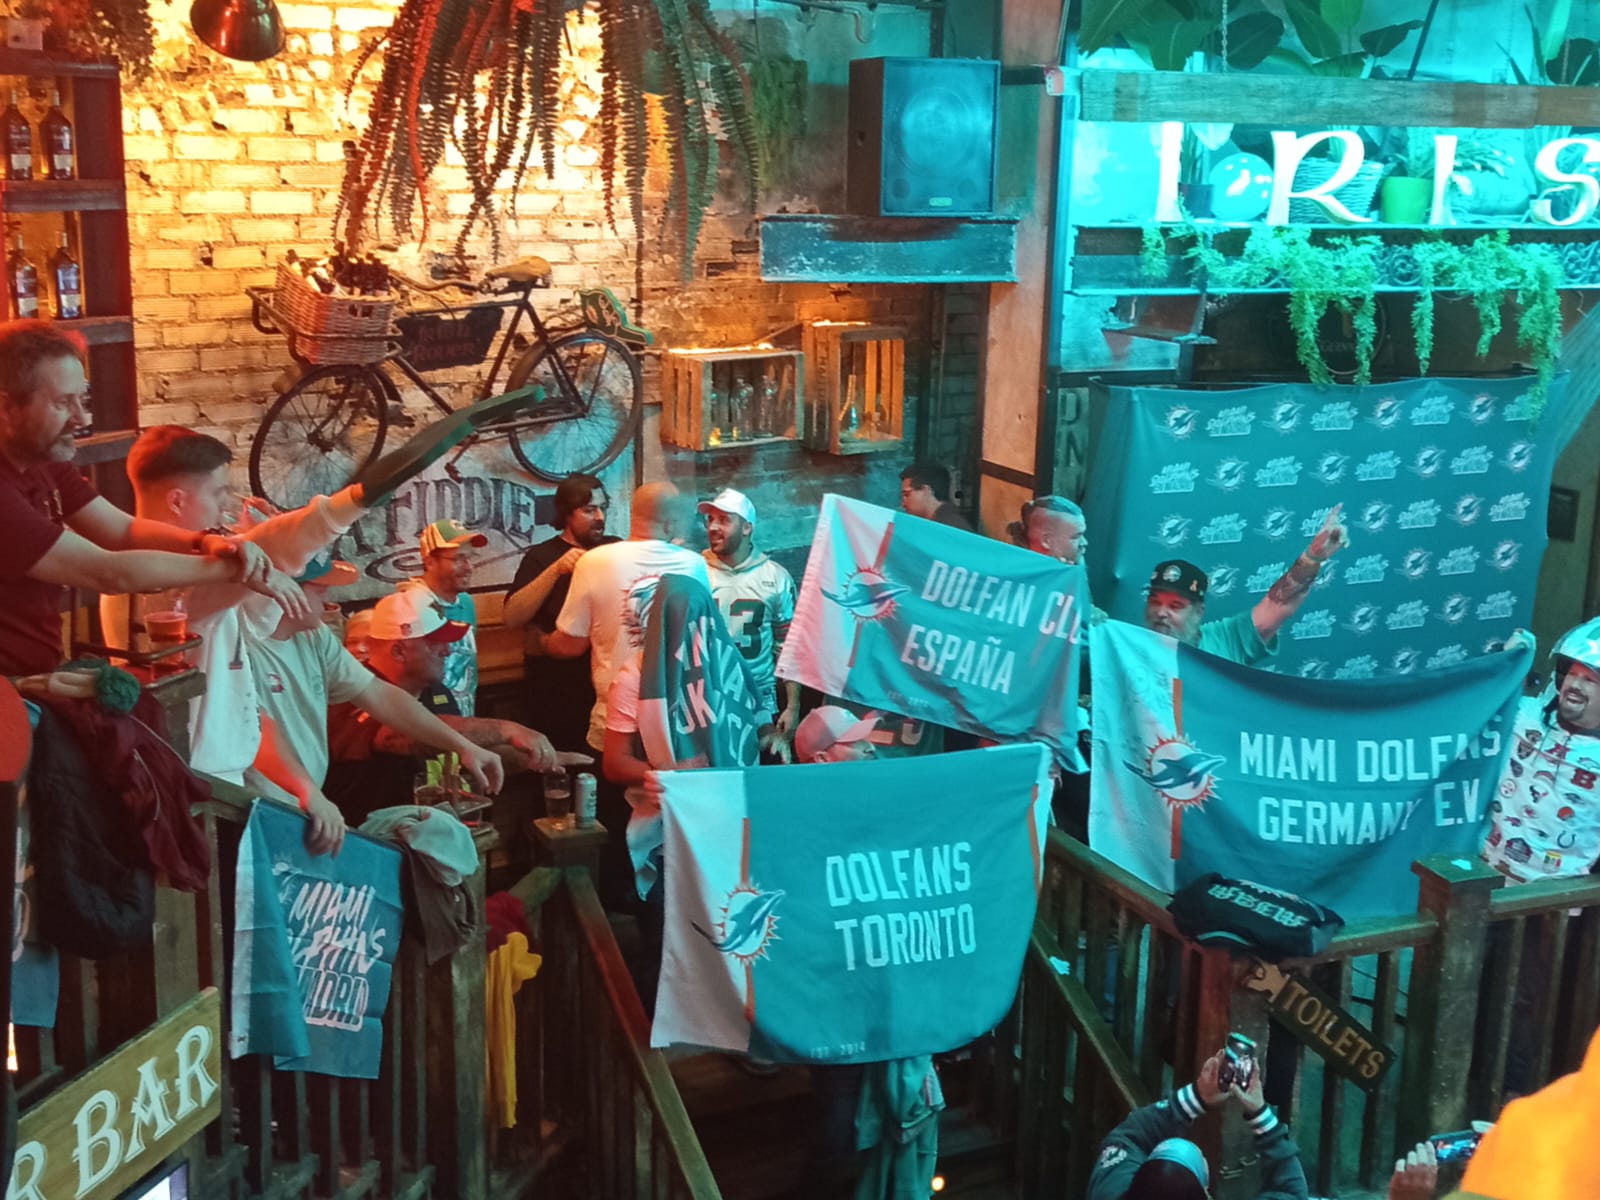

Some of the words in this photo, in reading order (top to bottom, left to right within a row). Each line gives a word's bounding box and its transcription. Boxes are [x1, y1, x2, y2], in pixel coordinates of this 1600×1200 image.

[921, 559, 1036, 628] DOLFAN
[901, 624, 1016, 695] ESPAÑA
[1240, 731, 1338, 783] MIAMI
[1258, 796, 1423, 846] GERMANY
[1434, 778, 1485, 827] E.V.
[288, 880, 376, 930] MIAMI
[826, 842, 972, 908] DOLFANS
[835, 903, 977, 971] TORONTO
[1283, 979, 1386, 1079] TOILETS
[72, 1025, 218, 1200] BAR
